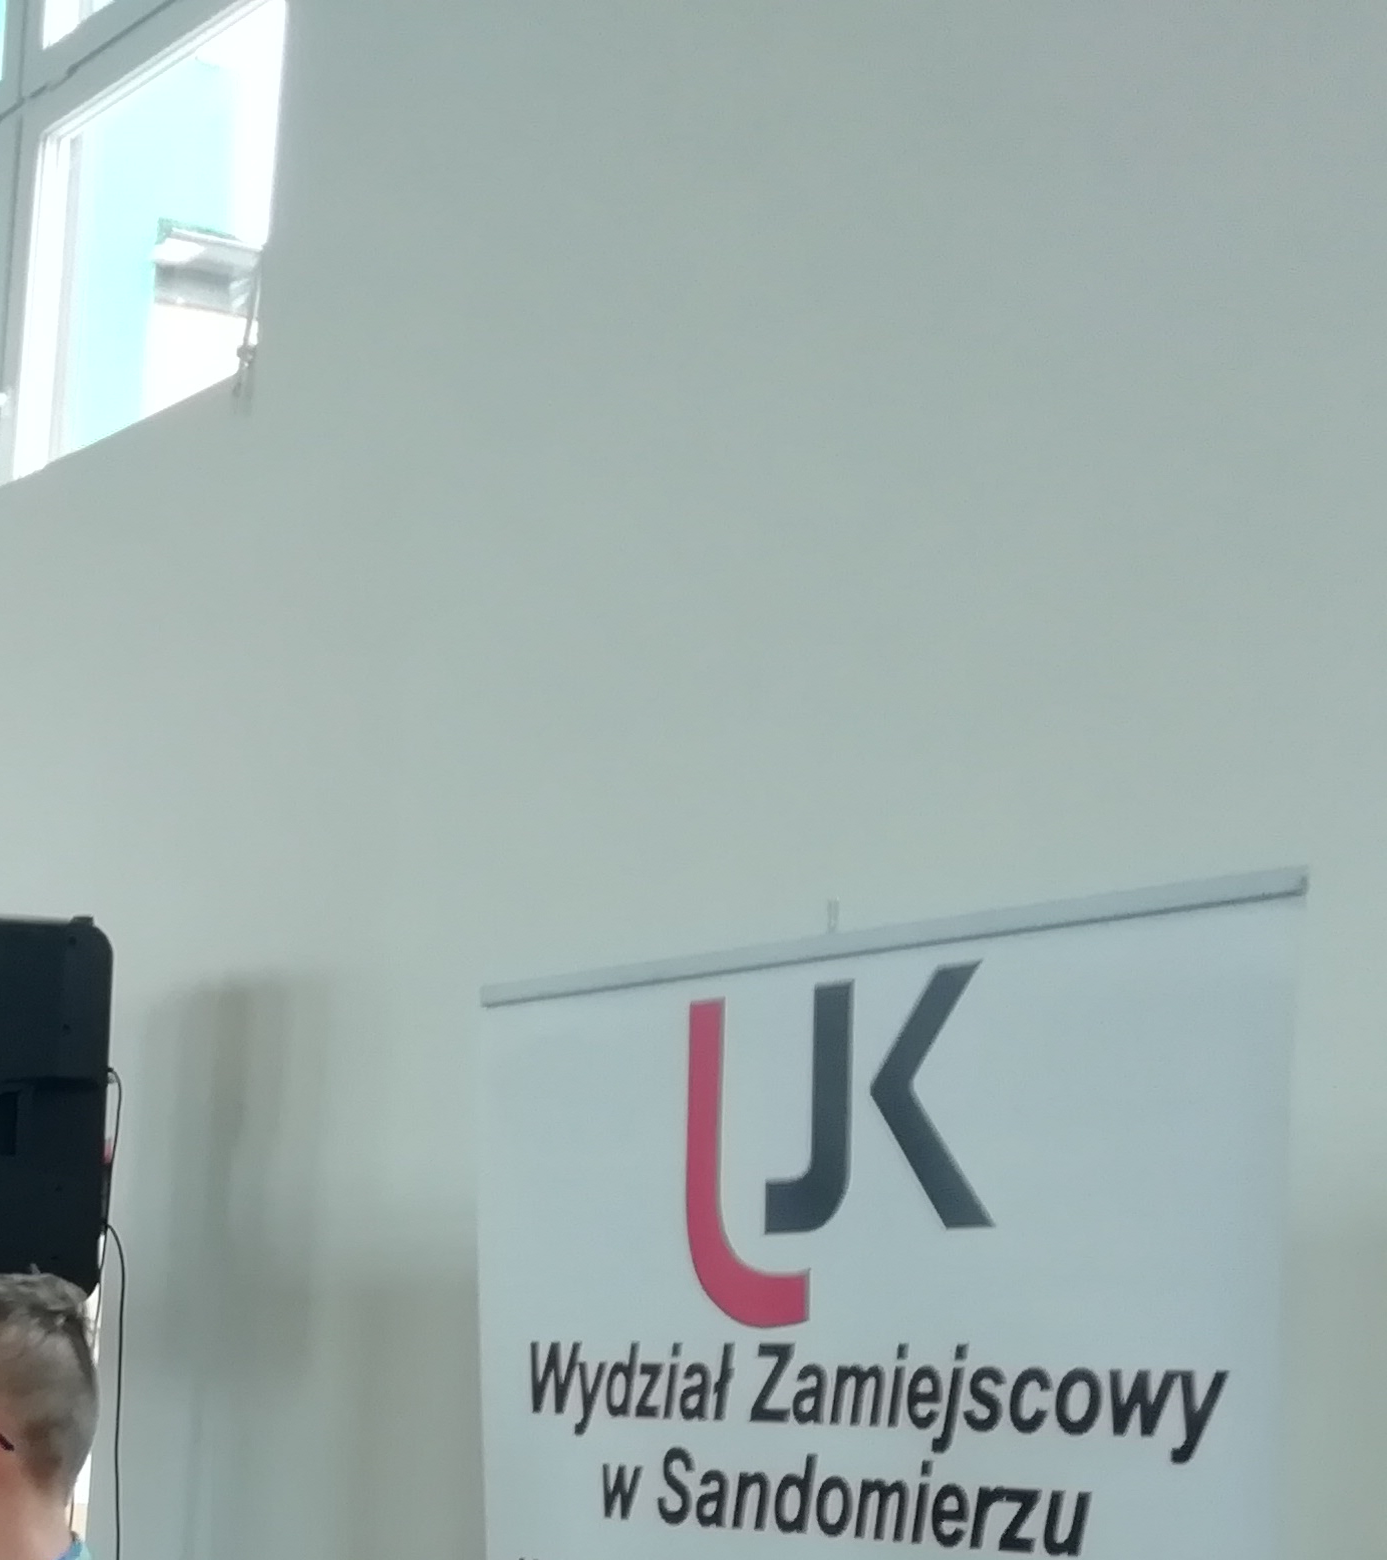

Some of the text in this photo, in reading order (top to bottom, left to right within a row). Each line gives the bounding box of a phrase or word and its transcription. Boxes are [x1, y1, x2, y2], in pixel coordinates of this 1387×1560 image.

[530, 1341, 1230, 1464] Wydział Zamiejscowy
[602, 1450, 1091, 1557] w Sandomierzu
